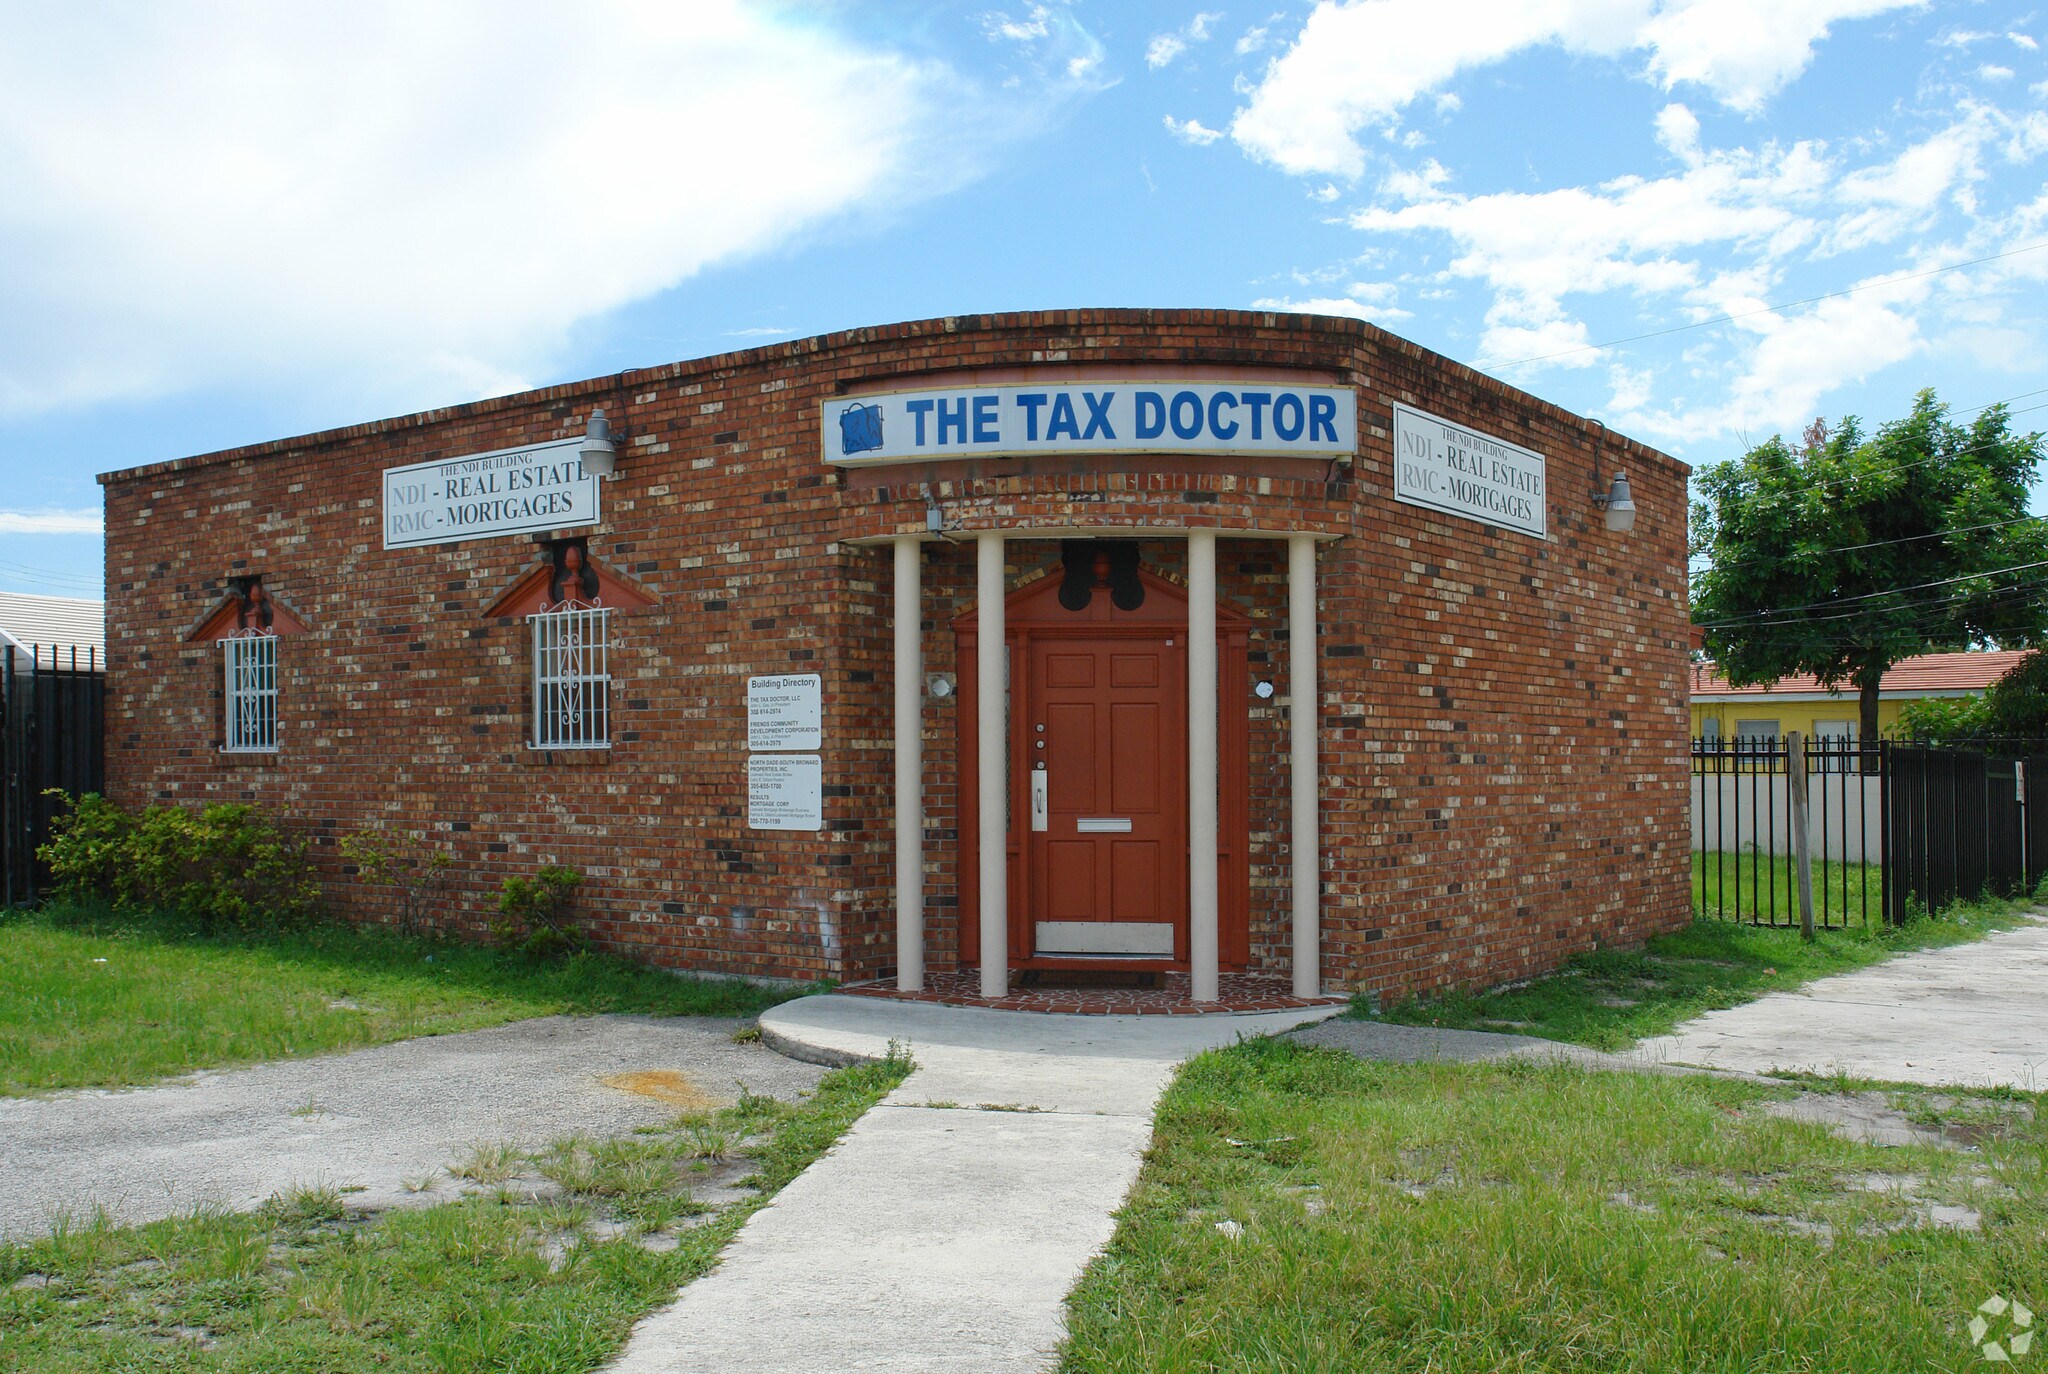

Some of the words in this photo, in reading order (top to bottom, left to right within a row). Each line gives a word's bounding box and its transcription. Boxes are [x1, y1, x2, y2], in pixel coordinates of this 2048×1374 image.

[906, 395, 1000, 446] THE
[1016, 392, 1117, 441] TAX
[1135, 390, 1339, 442] DOCTOR
[1403, 430, 1433, 461] NDI
[1447, 445, 1488, 479] REAL
[1492, 461, 1541, 496] ESTATE
[1441, 427, 1458, 444] THE
[1459, 433, 1472, 448] NDI
[1473, 437, 1508, 461] BUILDING
[440, 465, 460, 477] THE
[461, 462, 479, 474] NDI
[482, 453, 533, 470] BUILDING
[393, 483, 427, 507] NDI
[445, 473, 501, 499] REAL
[1402, 462, 1439, 494] RMC
[1448, 476, 1532, 521] MORTGAGES
[392, 509, 434, 535] RMC
[447, 491, 572, 527] MORTGAGES
[752, 680, 781, 689] Building
[783, 679, 816, 687] Directory
